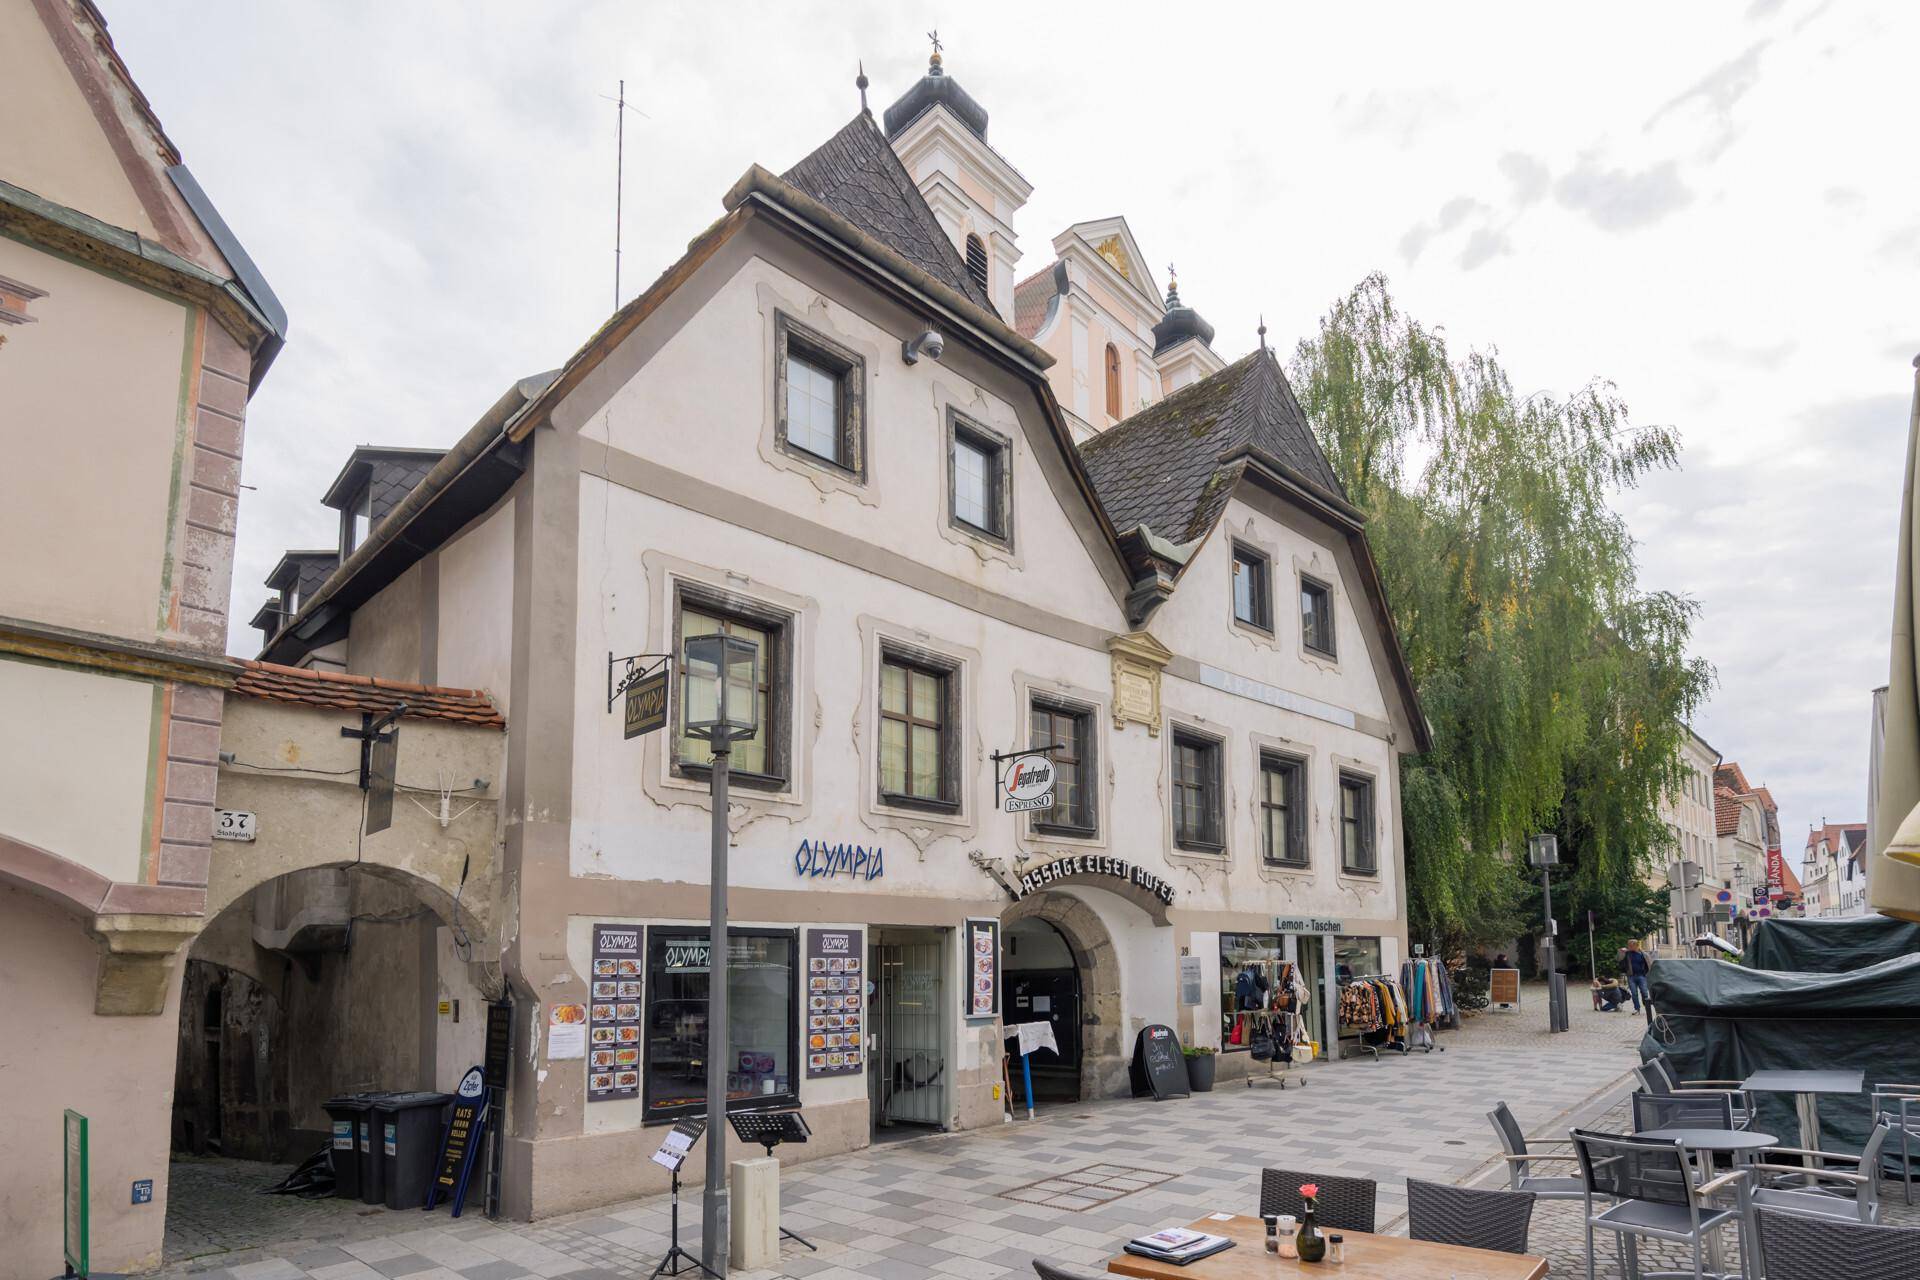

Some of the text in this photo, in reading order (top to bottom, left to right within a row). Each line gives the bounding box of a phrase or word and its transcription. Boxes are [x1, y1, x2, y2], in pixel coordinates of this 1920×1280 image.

[627, 686, 664, 723] OLYMPIA
[1009, 763, 1050, 792] Segafredo
[1009, 795, 1049, 810] ESPRESSO
[222, 812, 249, 829] 37
[795, 838, 883, 880] OLYMPIA
[1136, 865, 1177, 905] HOFER
[1276, 917, 1303, 930] Lemon
[1311, 919, 1341, 932] Taschen
[600, 935, 638, 949] OLYMPIA
[822, 937, 849, 949] OLYMPIA
[1181, 946, 1189, 957] 39
[463, 1080, 479, 1094] Zipfer
[456, 1107, 472, 1119] RATS
